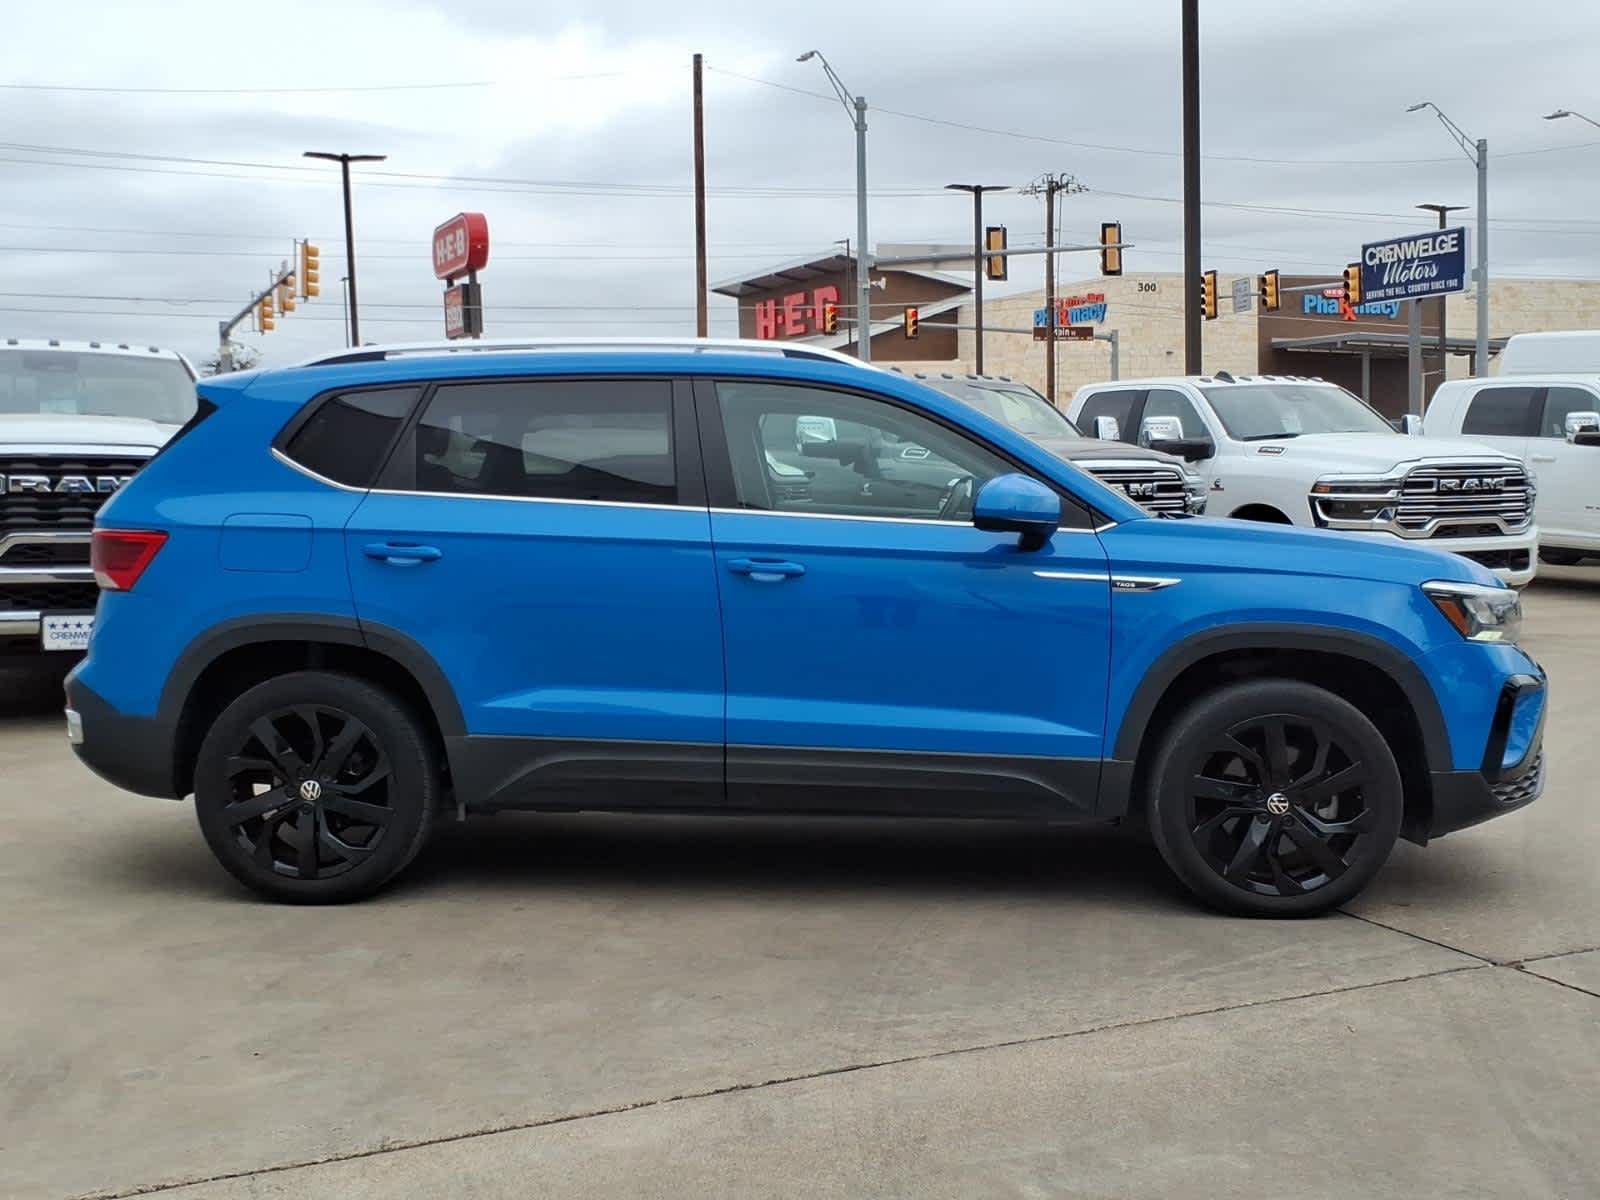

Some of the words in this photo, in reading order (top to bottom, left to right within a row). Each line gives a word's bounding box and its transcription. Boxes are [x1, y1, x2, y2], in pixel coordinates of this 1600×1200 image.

[1365, 233, 1459, 266] CRENWELGE
[1383, 260, 1440, 285] Motors
[1137, 282, 1157, 292] 300
[1407, 282, 1430, 294] COUNTRY
[9, 475, 134, 493] RAM
[1109, 483, 1153, 496] AM
[1439, 477, 1506, 491] RAM
